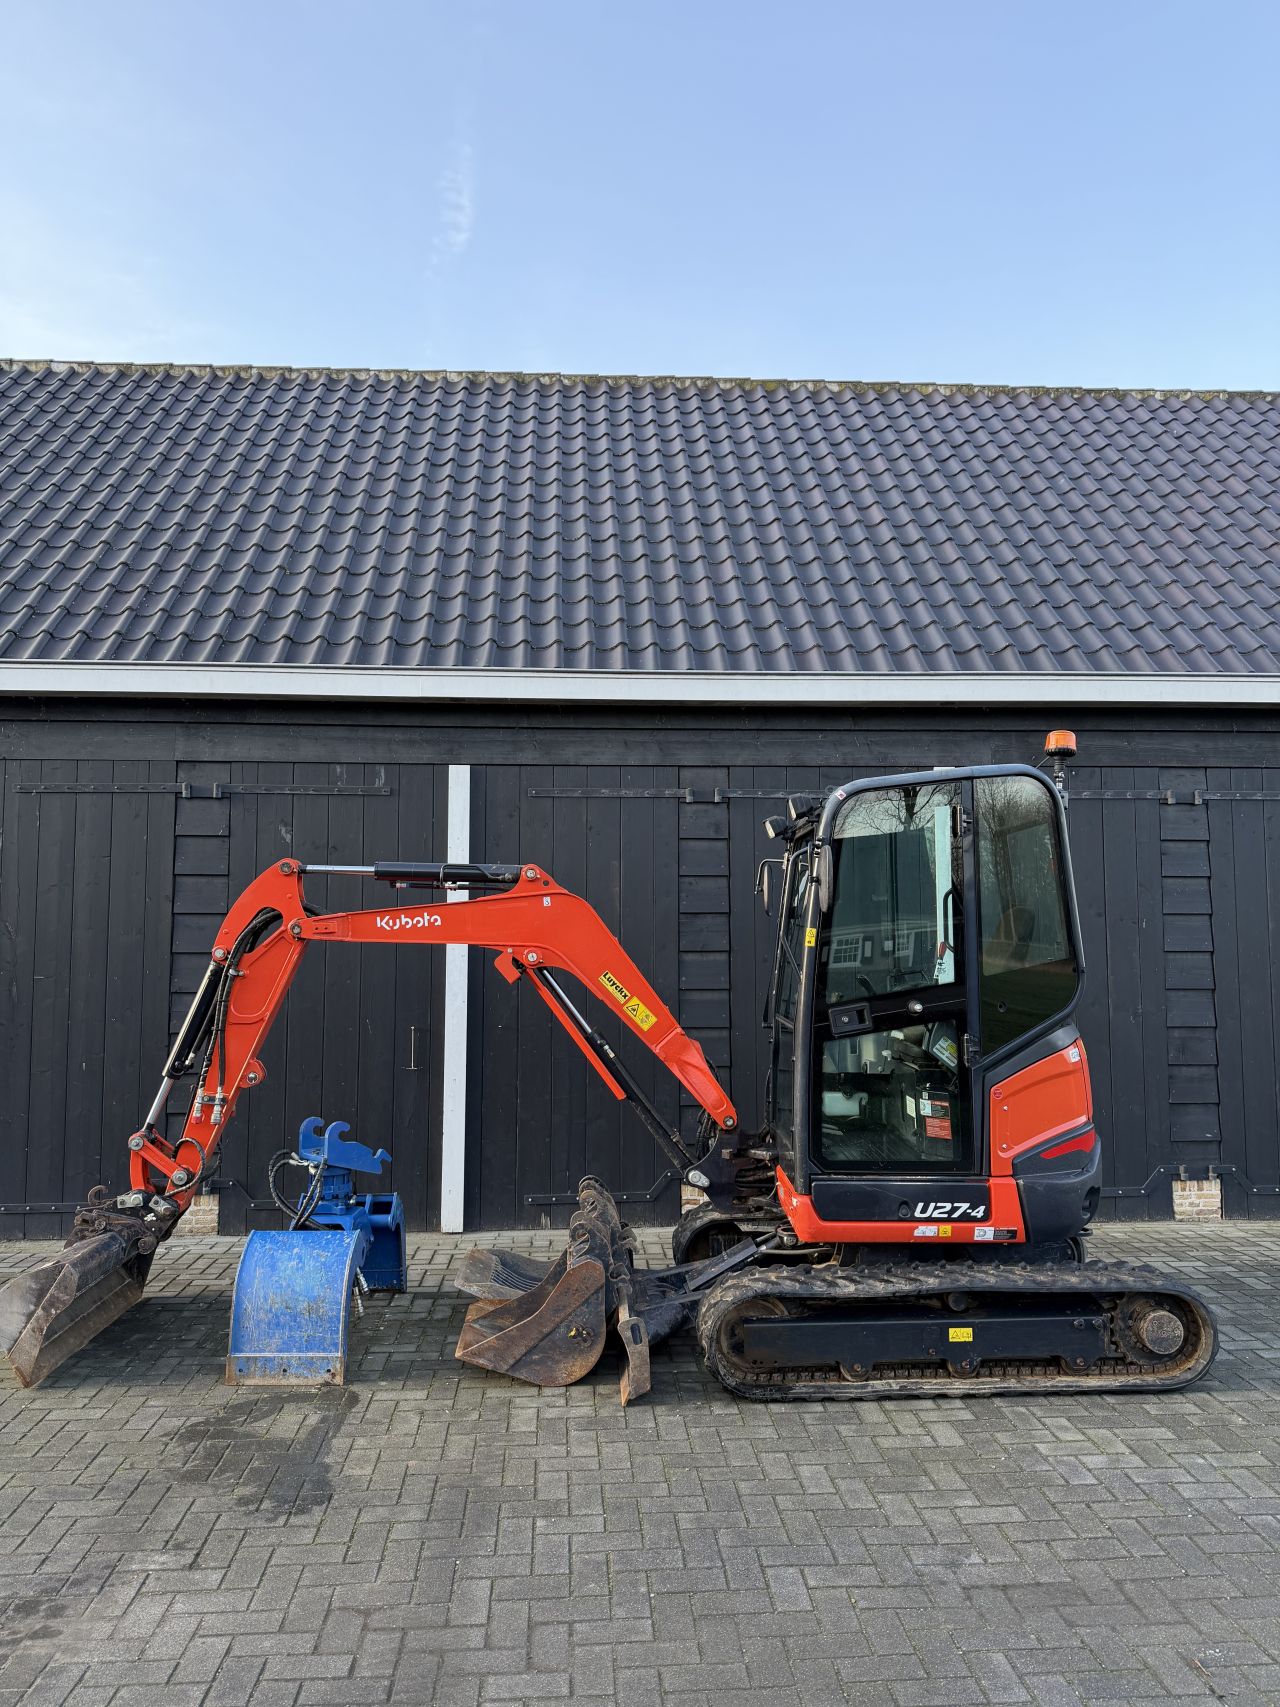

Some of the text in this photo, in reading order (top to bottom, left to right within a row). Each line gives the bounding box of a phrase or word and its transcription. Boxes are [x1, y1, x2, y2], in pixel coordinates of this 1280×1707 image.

[376, 912, 441, 930] Kubota
[602, 971, 629, 1000] Luyckx
[914, 1202, 986, 1218] U27-4
